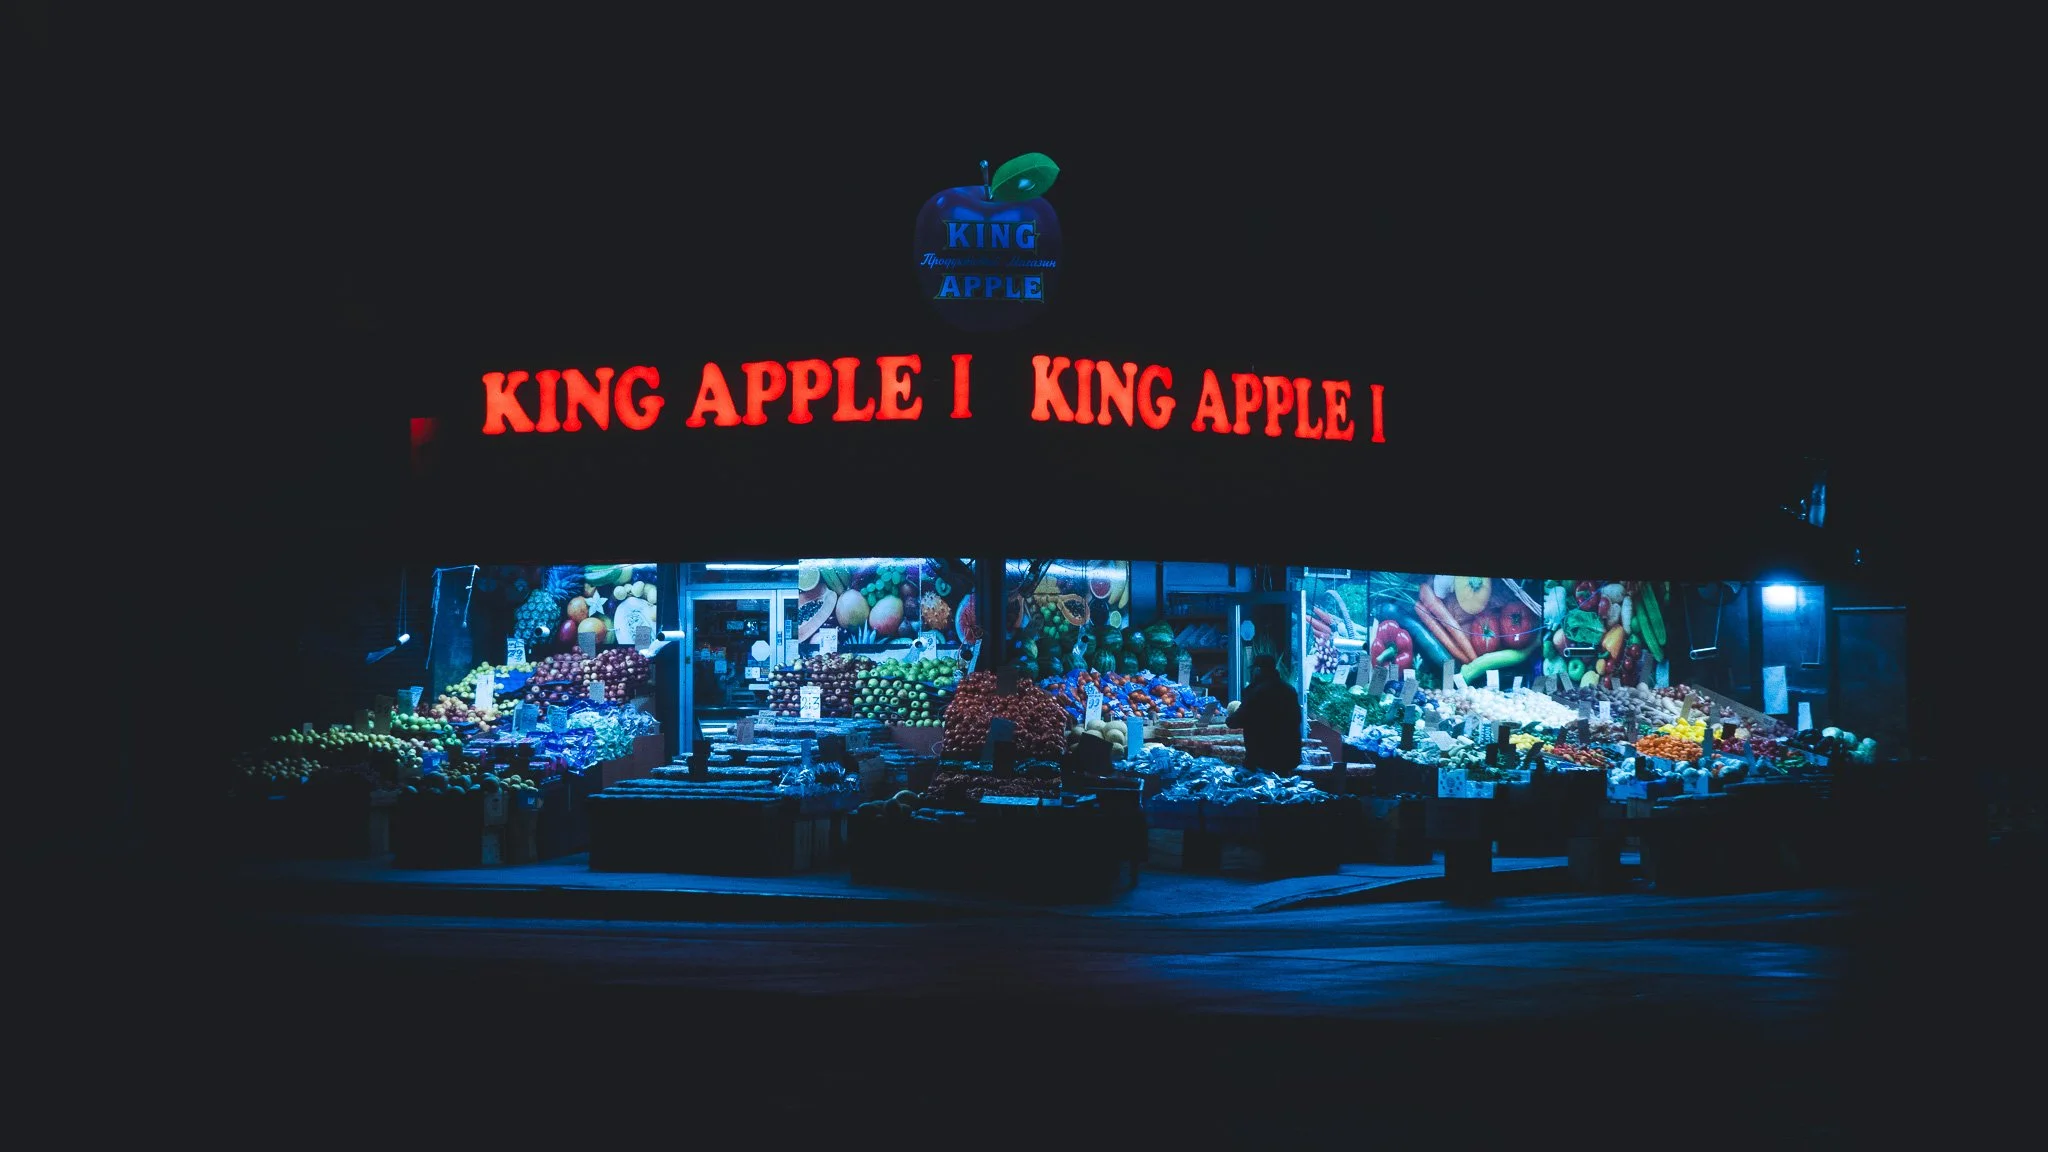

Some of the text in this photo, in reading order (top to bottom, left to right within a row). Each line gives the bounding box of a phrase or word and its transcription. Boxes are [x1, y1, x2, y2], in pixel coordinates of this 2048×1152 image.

[948, 222, 1035, 249] KING
[940, 275, 1042, 299] APPLE
[482, 354, 972, 435] KING APPLE I
[1031, 355, 1385, 443] KING APPLE I
